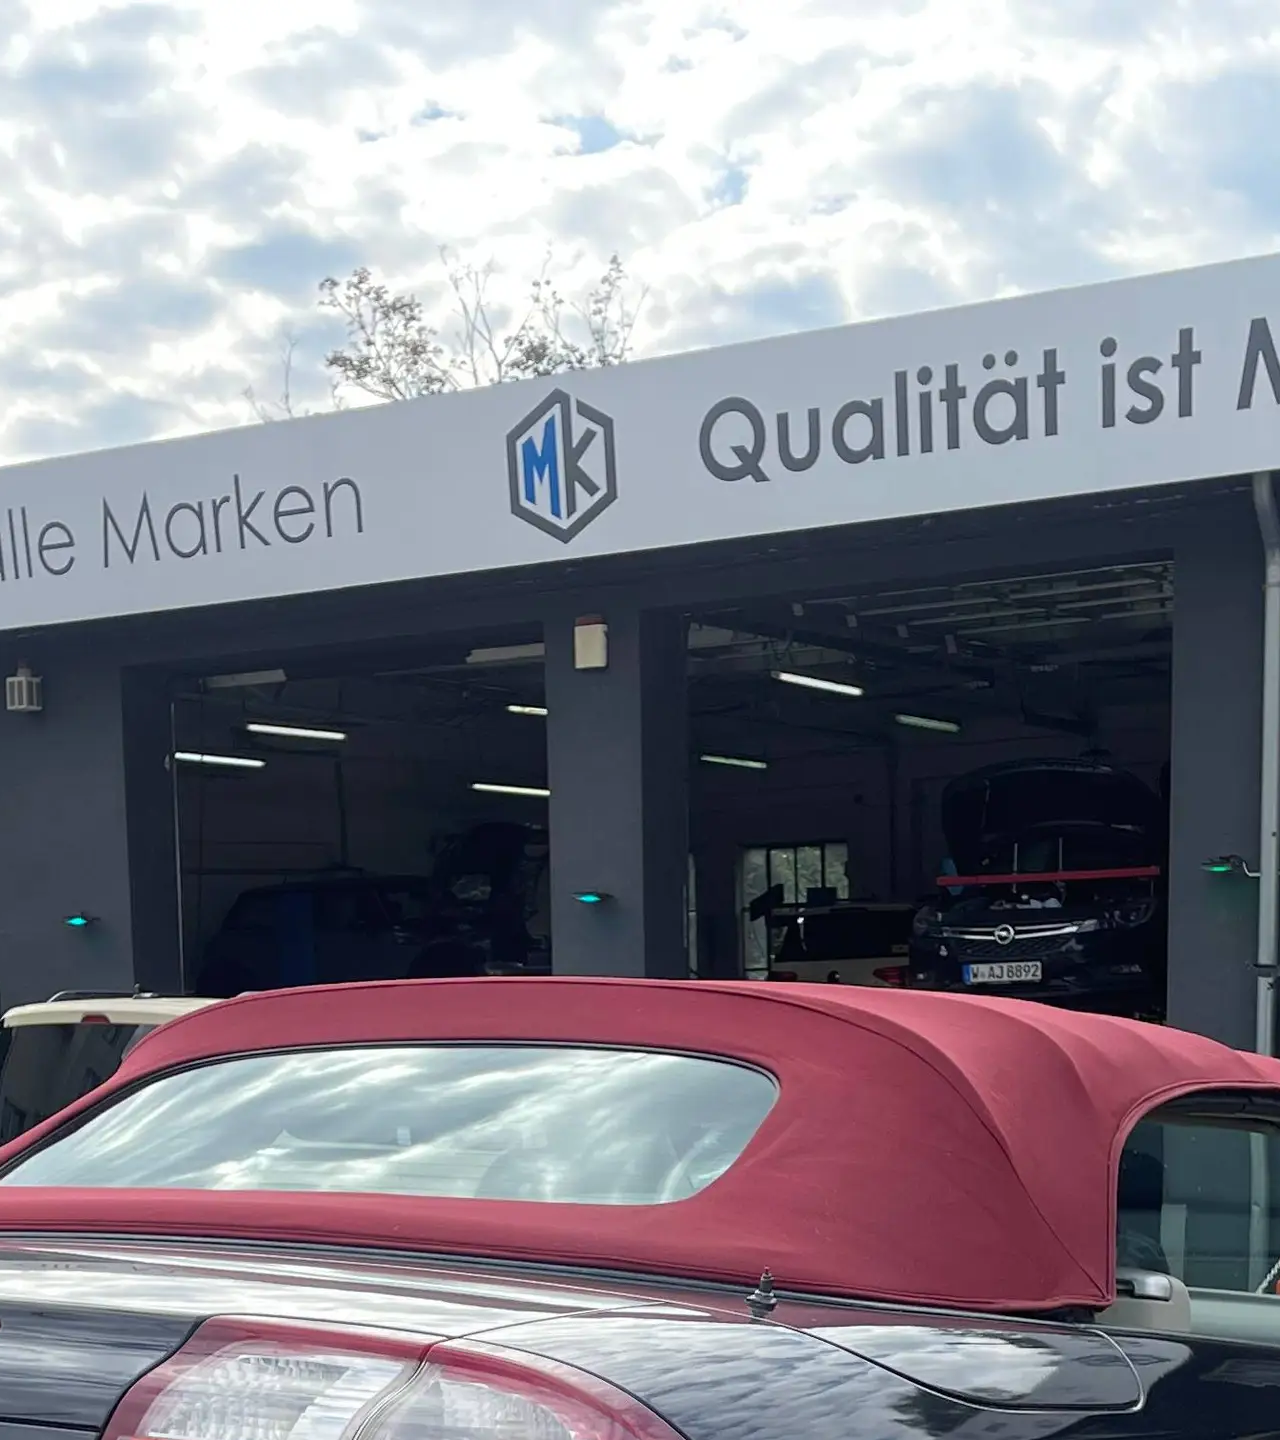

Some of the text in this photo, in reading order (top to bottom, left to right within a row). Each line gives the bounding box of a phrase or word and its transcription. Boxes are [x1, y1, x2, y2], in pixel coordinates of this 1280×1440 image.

[699, 348, 1066, 483] Qualität
[1099, 327, 1202, 428] ist
[103, 473, 363, 568] Marken
[971, 966, 980, 980] W
[987, 964, 1004, 980] AJ
